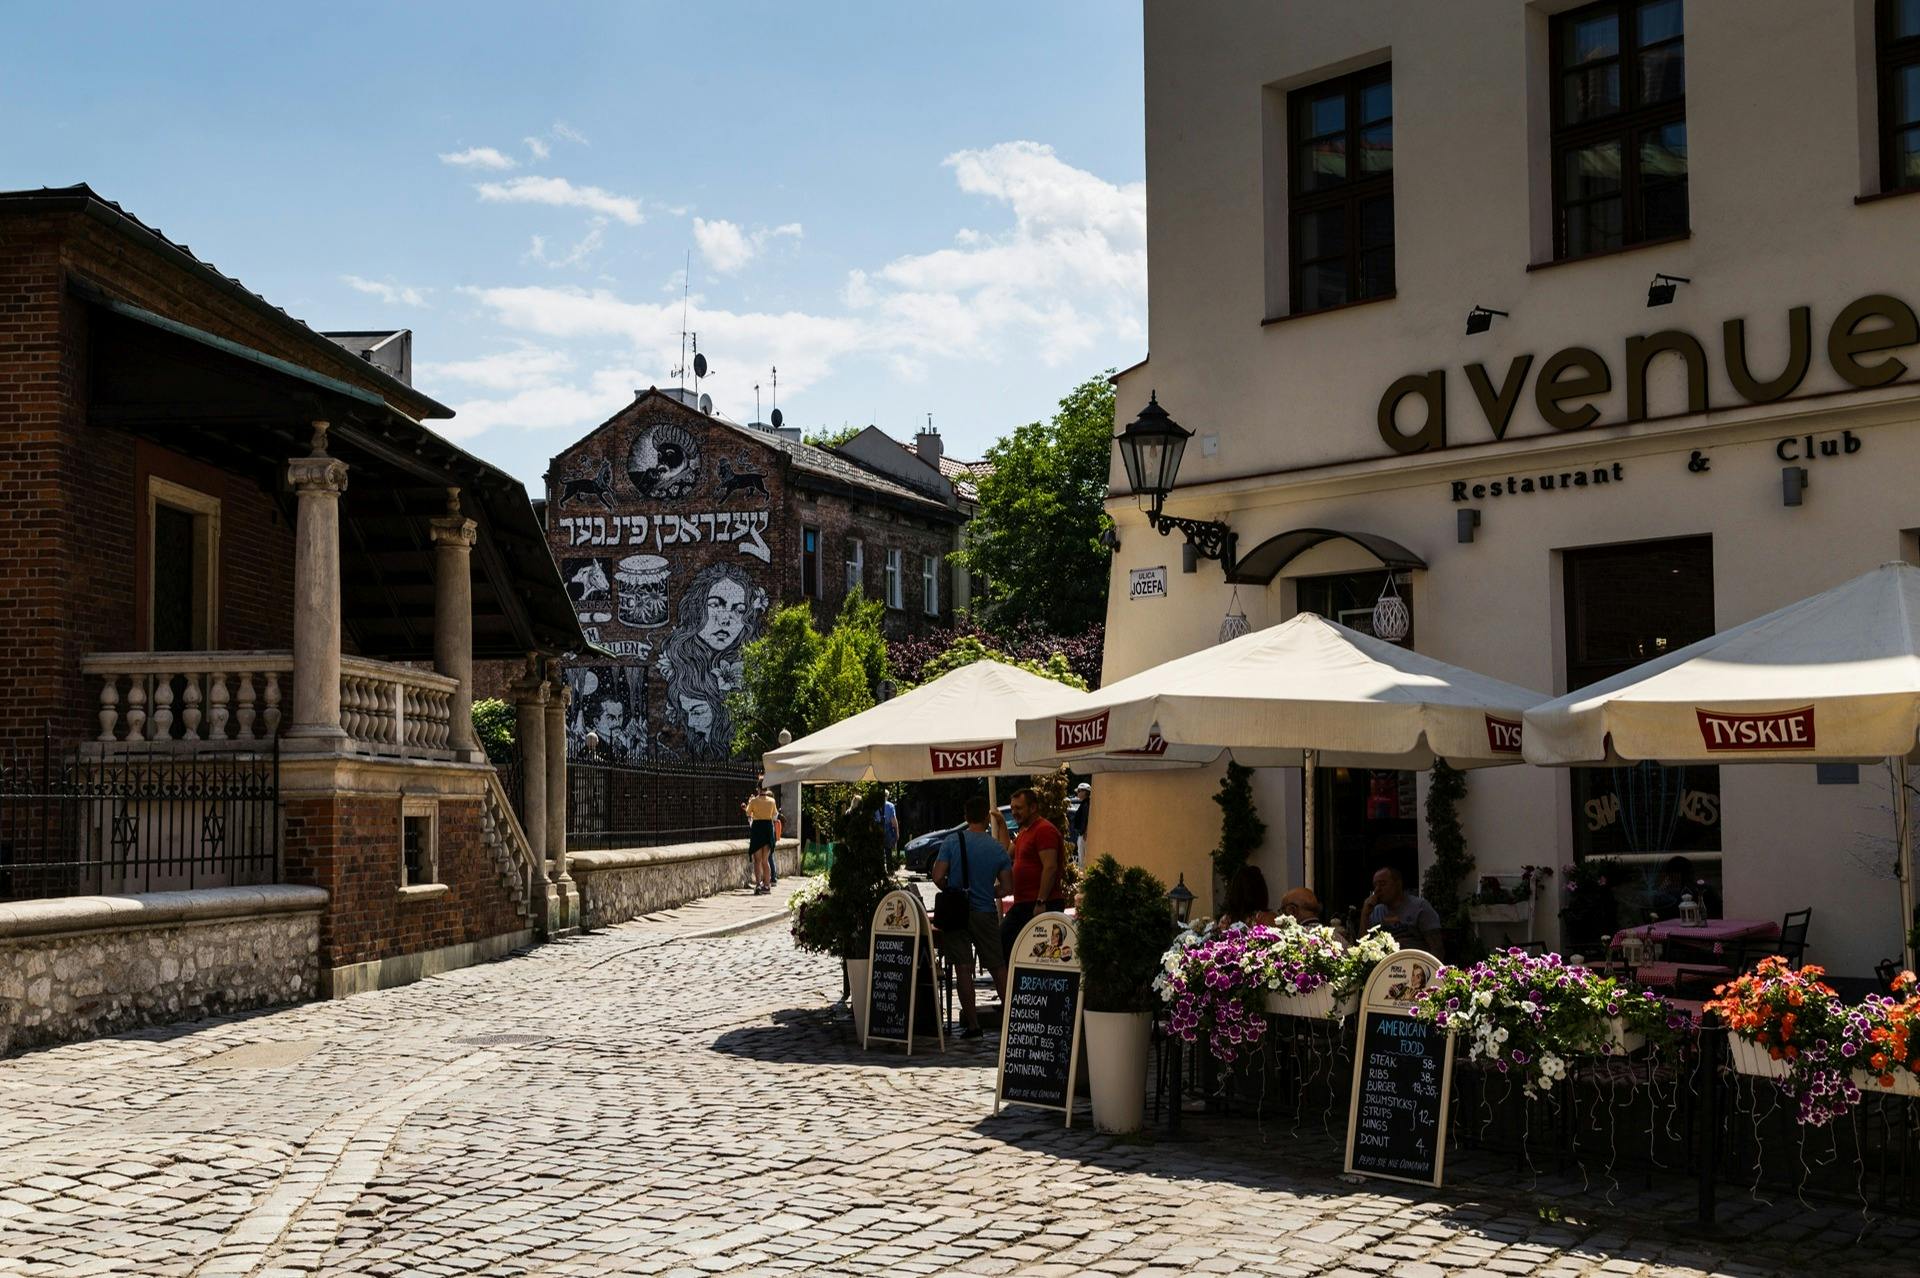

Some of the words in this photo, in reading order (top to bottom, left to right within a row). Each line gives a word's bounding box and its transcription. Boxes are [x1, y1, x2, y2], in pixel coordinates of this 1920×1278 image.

[1377, 294, 1920, 453] avenue
[1451, 461, 1624, 502] Restaurant
[1687, 450, 1711, 474] &
[1776, 431, 1861, 463] Club
[1138, 571, 1155, 580] ULICA
[1131, 579, 1164, 596] JÓZEFA
[1059, 717, 1105, 746] TYSKIE
[1491, 722, 1522, 747] TYS
[1705, 715, 1808, 744] TYSKIE
[934, 747, 998, 769] TYSKIE
[1012, 993, 1048, 1007] AMERICAN
[1010, 1007, 1040, 1020] ENGLISH
[1008, 1022, 1045, 1034] SCRAMBLED
[1047, 1024, 1064, 1036] EGGS
[1377, 1019, 1427, 1038] AMERICAN
[1006, 1047, 1026, 1058] SWEET
[1400, 1039, 1424, 1055] FOOD
[1370, 1053, 1398, 1068] STEAK
[1004, 1062, 1047, 1078] CONTINENTAL
[1369, 1068, 1389, 1080] RIBS
[1366, 1080, 1397, 1094] BURGER
[1365, 1093, 1413, 1111] DRUMSTICKS
[1362, 1105, 1393, 1119] STRIPS
[1362, 1119, 1388, 1132] WINGS
[1360, 1133, 1391, 1148] DONUT
